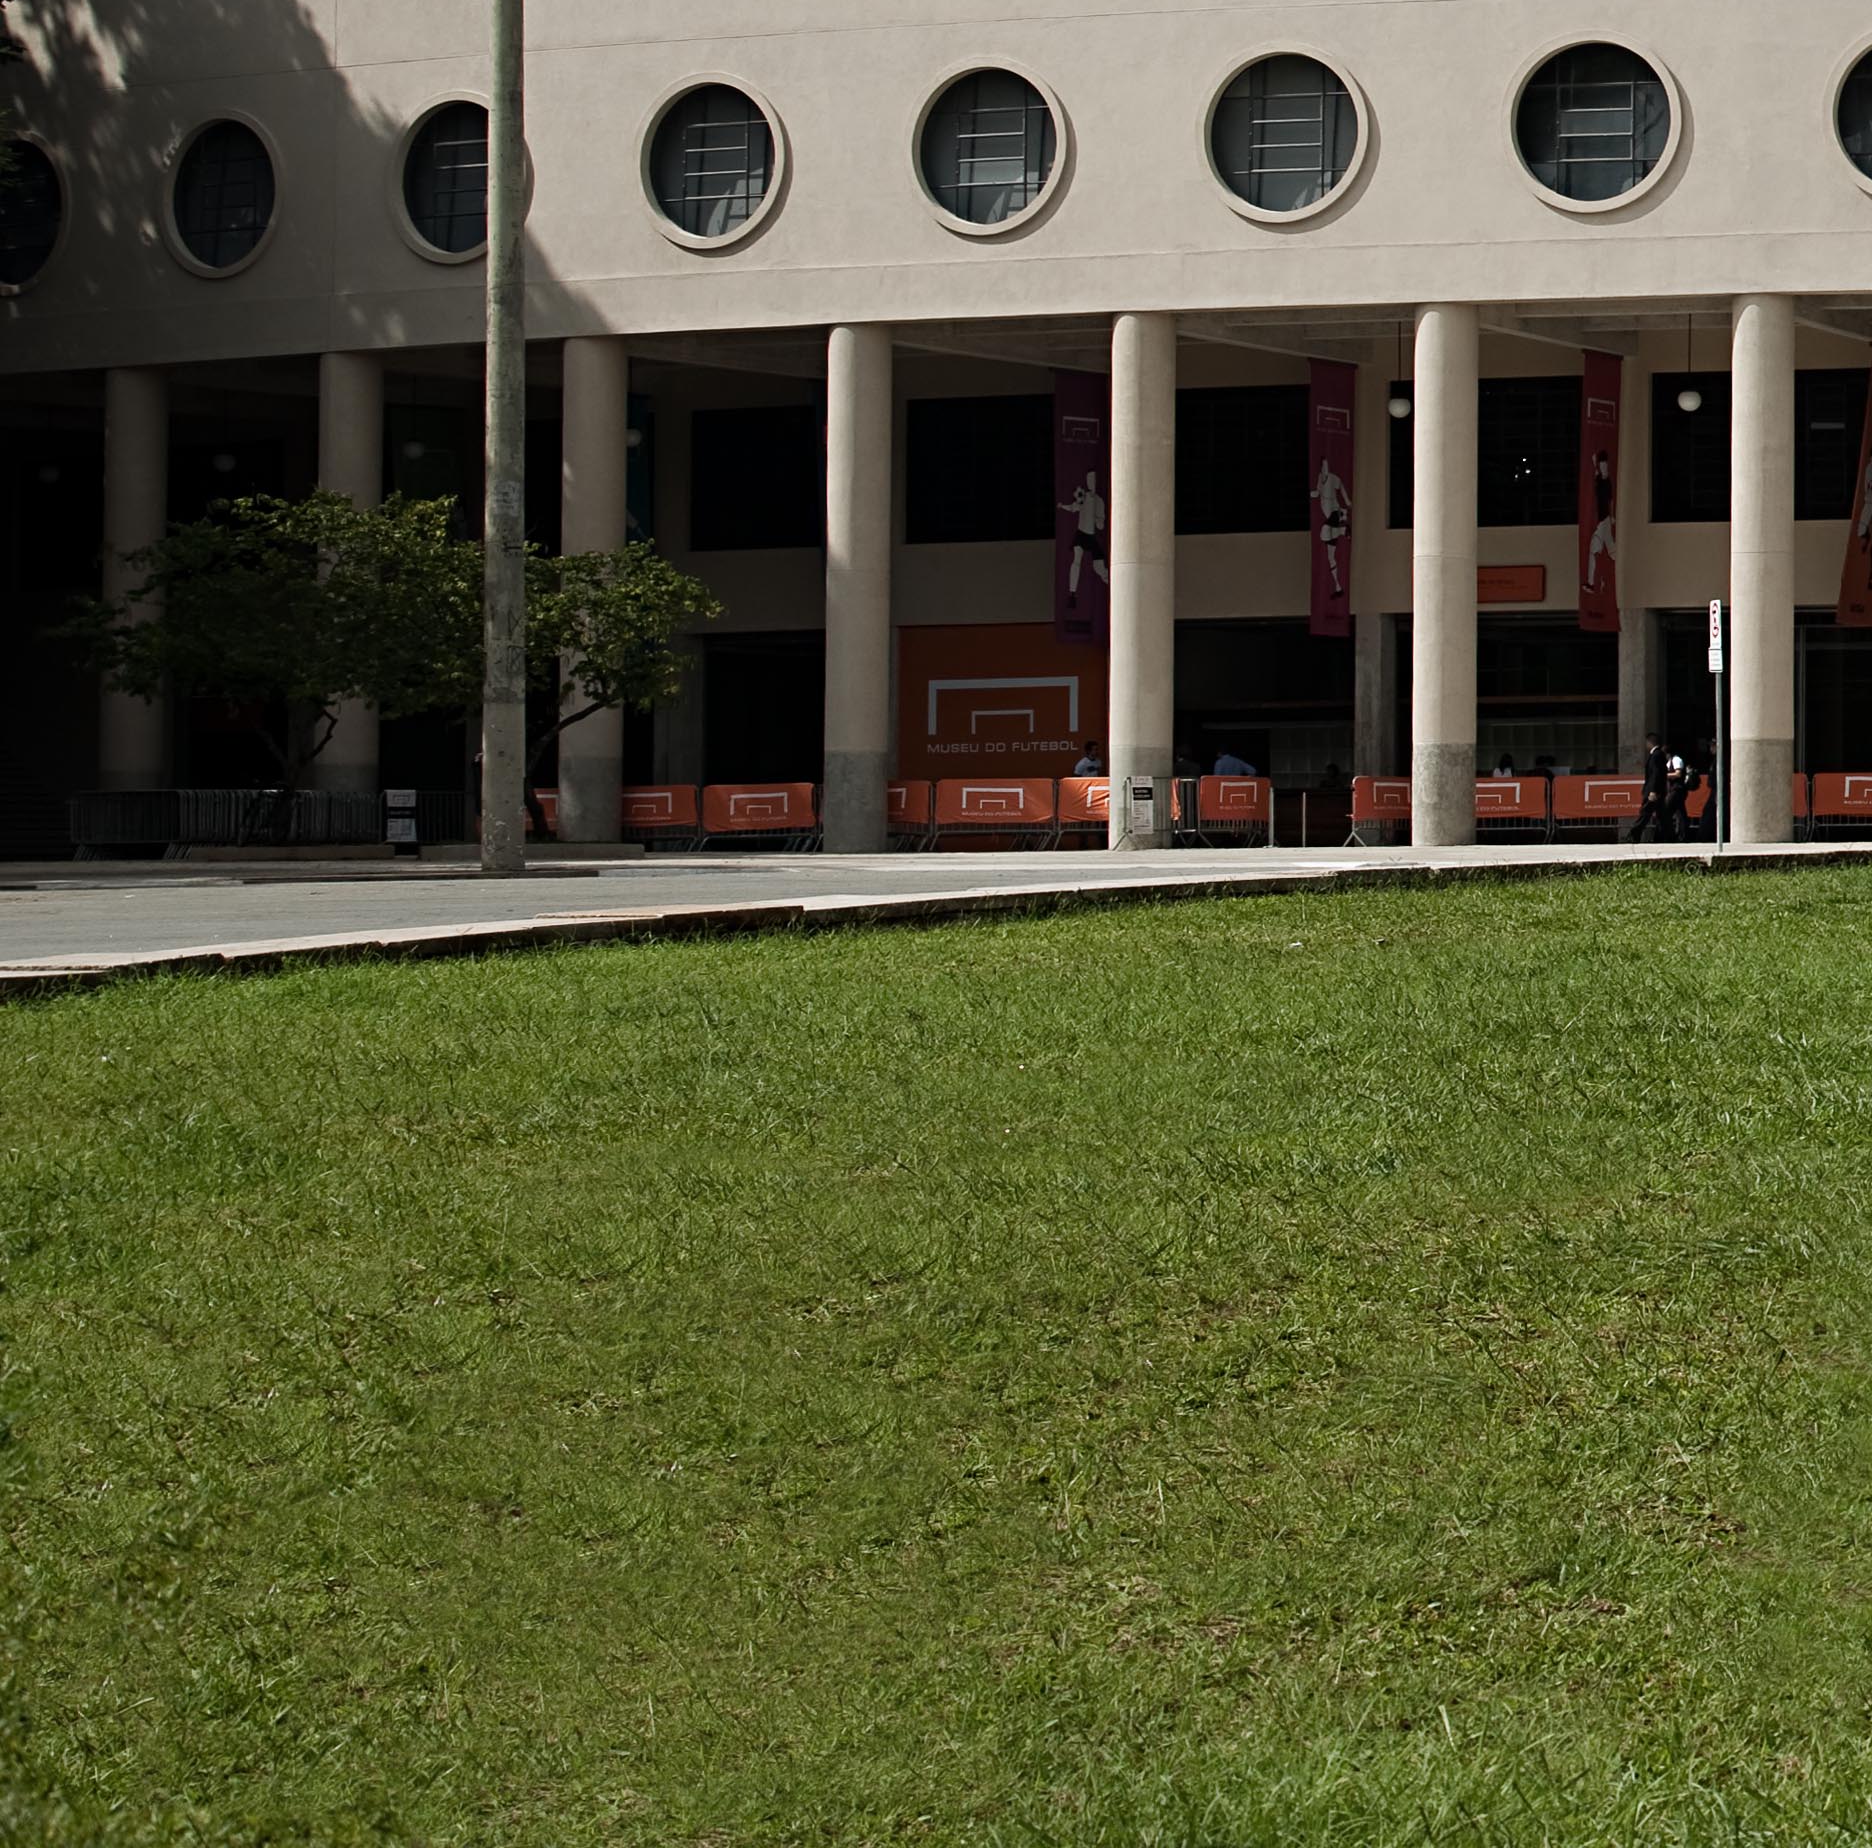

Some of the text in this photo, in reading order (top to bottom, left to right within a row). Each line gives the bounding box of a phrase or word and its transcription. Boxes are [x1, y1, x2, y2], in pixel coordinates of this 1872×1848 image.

[927, 740, 1079, 753] MUSEU DO FUTEBOL
